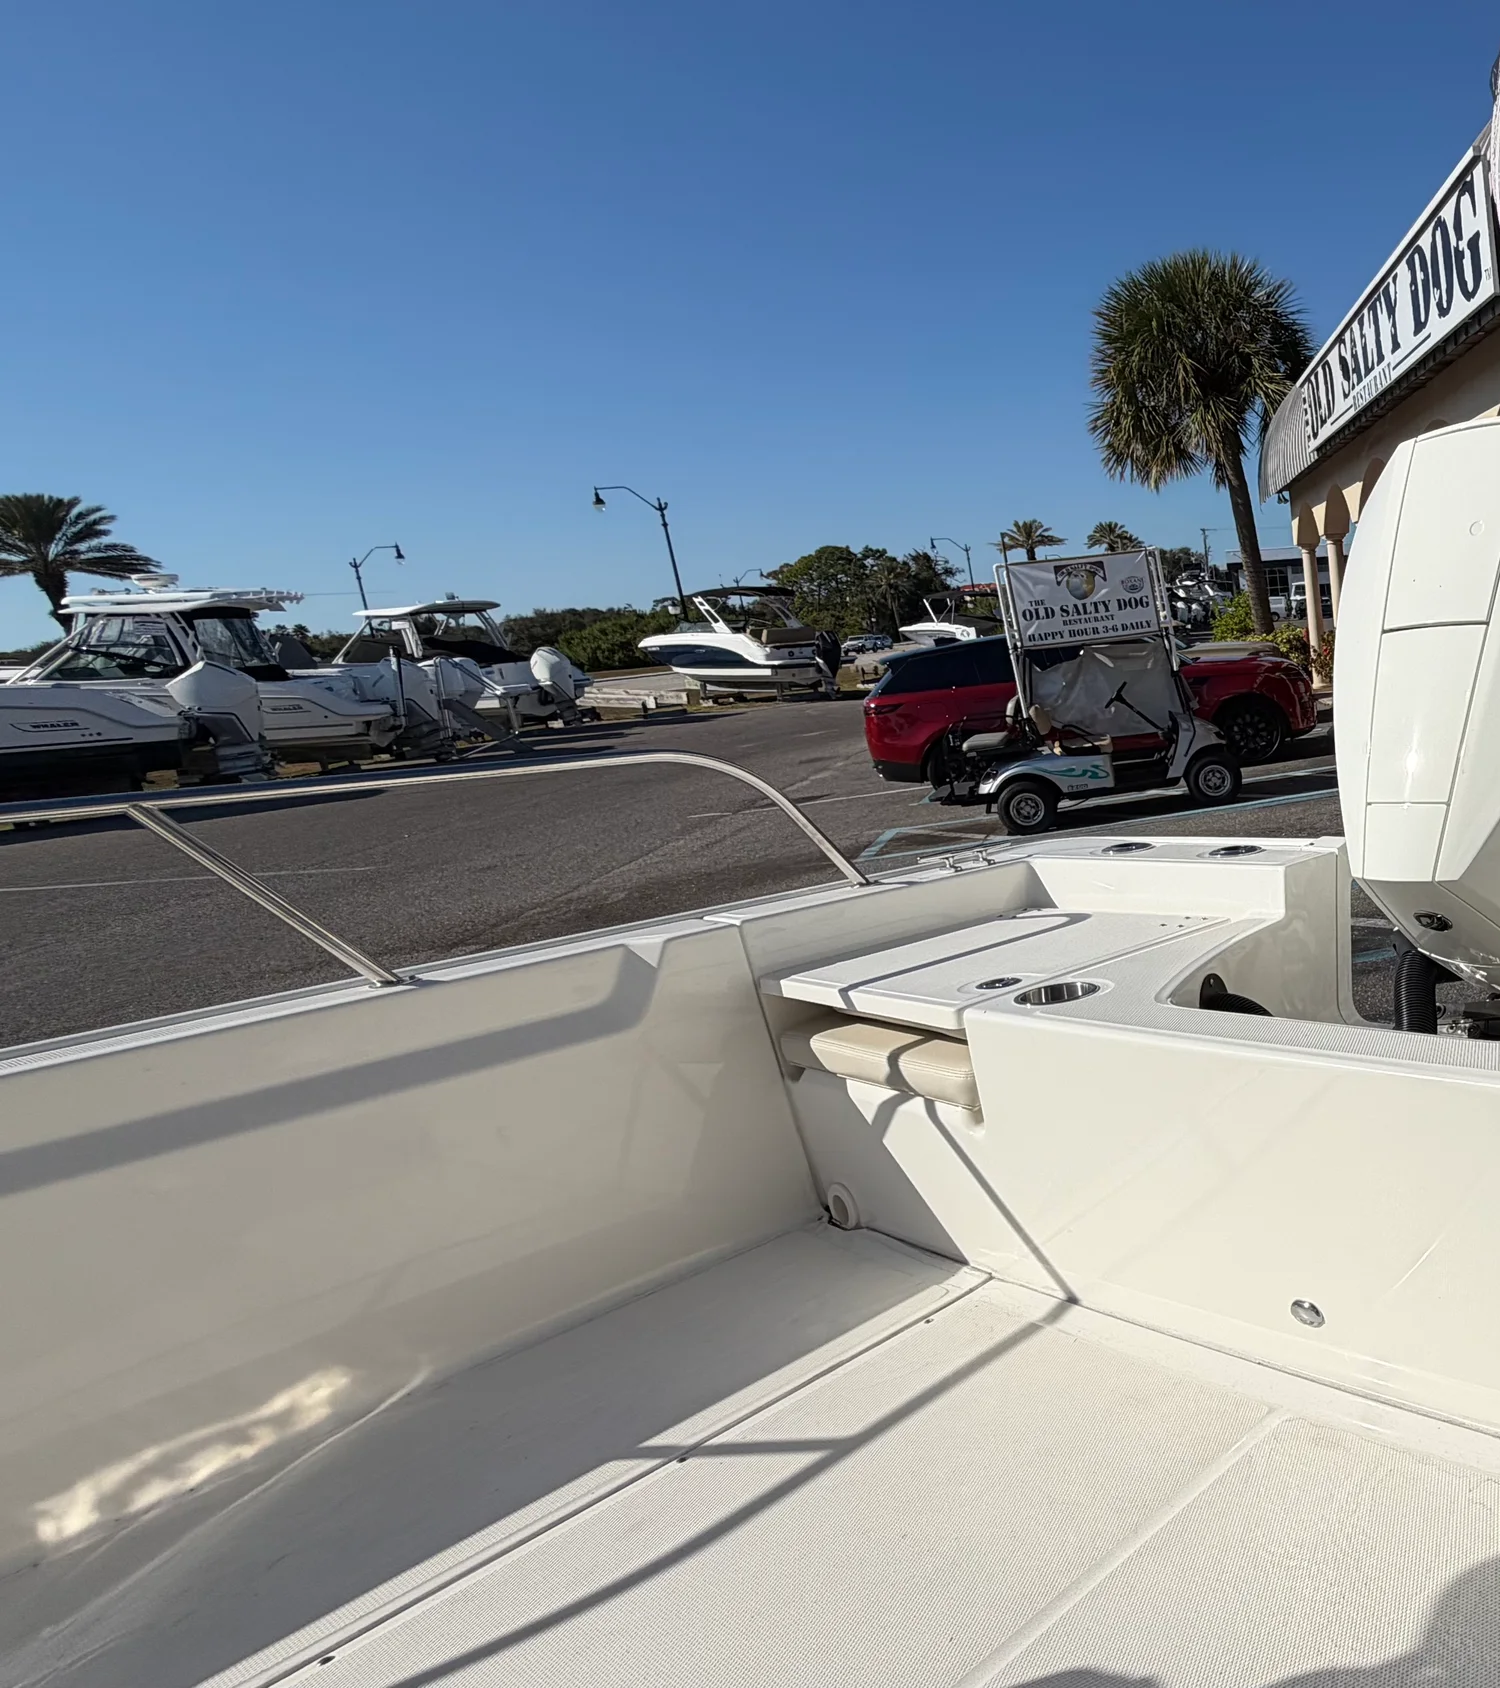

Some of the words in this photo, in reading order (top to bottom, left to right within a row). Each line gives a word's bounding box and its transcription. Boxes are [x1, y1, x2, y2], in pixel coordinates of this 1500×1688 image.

[1306, 360, 1336, 440] OLD
[1338, 271, 1401, 402] SALTY
[1406, 171, 1482, 337] DOG
[1022, 606, 1056, 622] OLD
[1060, 600, 1111, 618] SALTY
[1116, 595, 1150, 612] DOG
[1028, 599, 1046, 607] THE
[1028, 630, 1066, 642] HAPPY
[1068, 626, 1100, 638] HOUR
[1102, 624, 1119, 634] 3-6
[1121, 620, 1152, 632] DAILY
[1062, 614, 1115, 627] RESTAURANT
